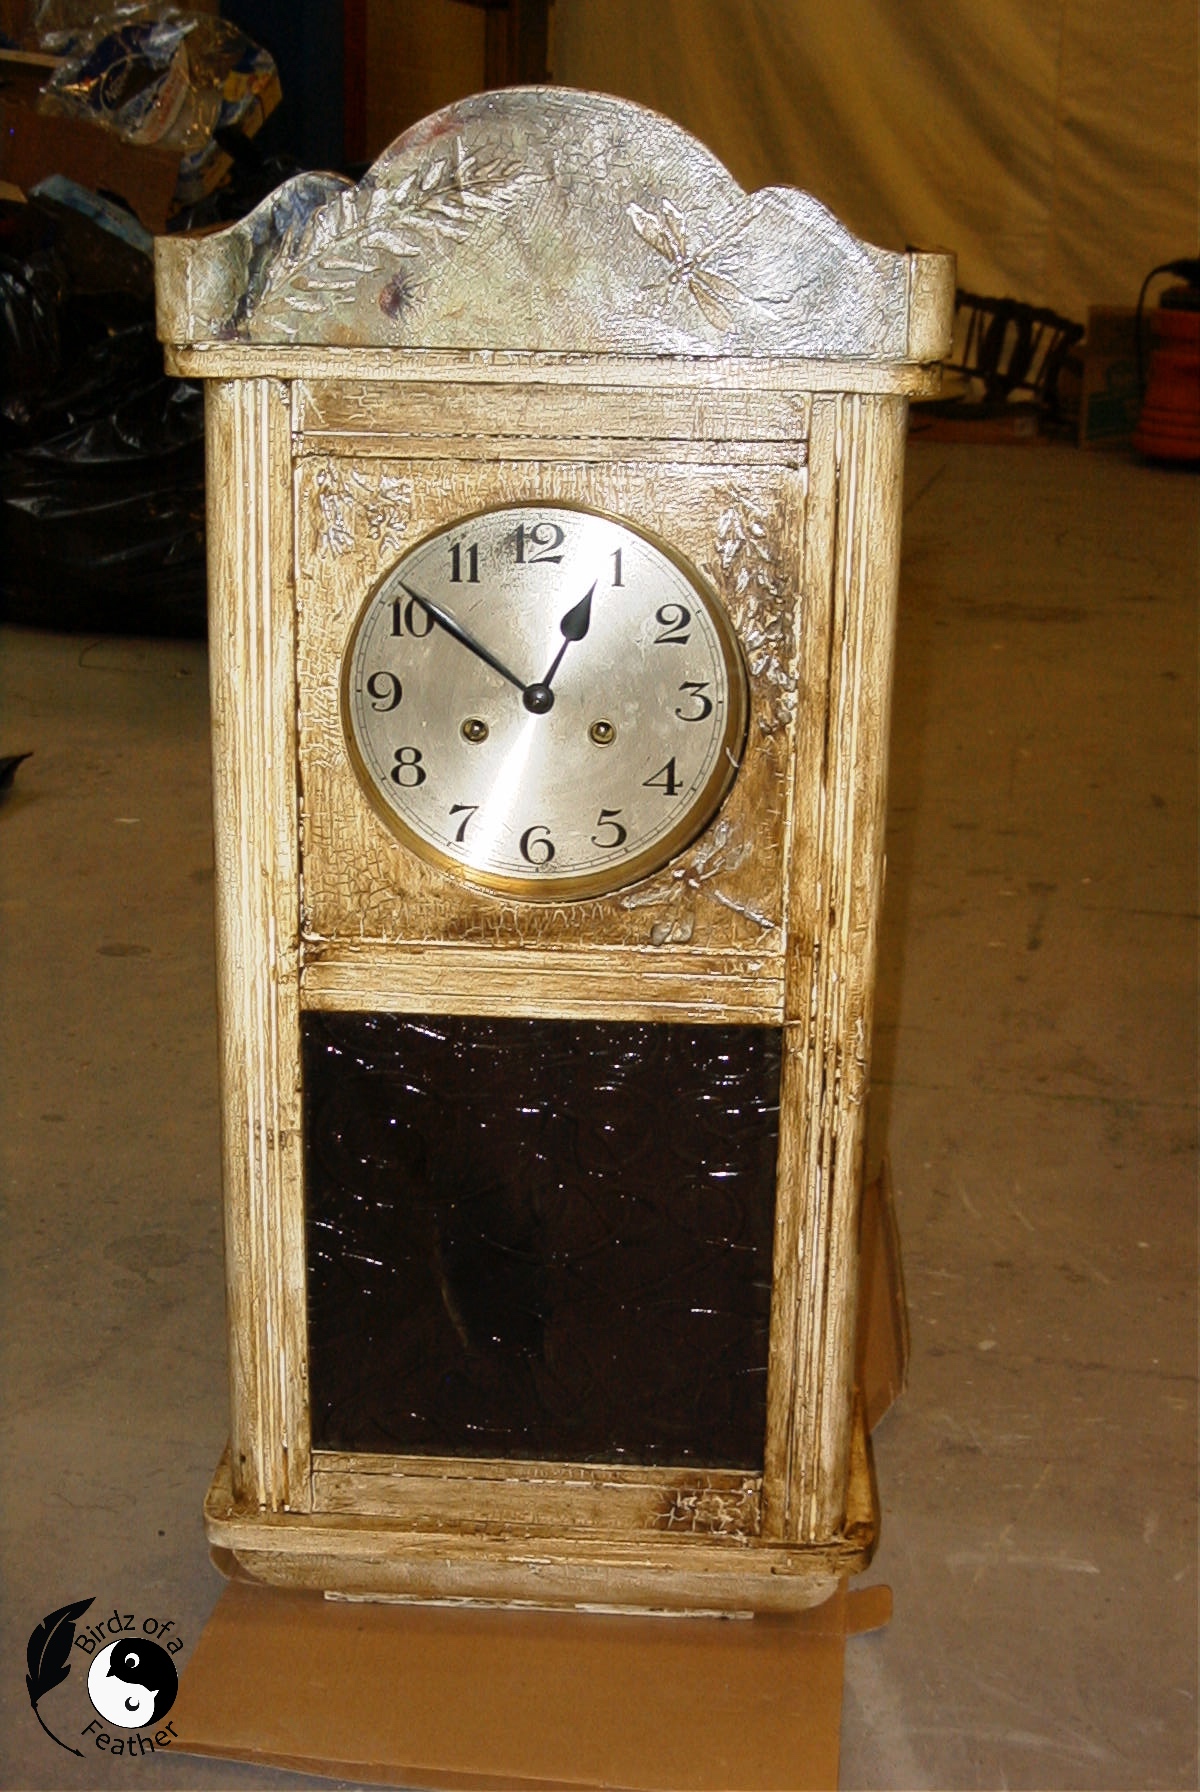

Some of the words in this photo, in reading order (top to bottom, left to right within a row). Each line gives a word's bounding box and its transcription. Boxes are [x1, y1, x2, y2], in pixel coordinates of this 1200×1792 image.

[448, 542, 480, 583] 11
[510, 522, 564, 563] 12
[610, 547, 626, 587] 1
[388, 597, 435, 638] 10
[654, 603, 691, 645] 2
[367, 671, 403, 712] 9
[675, 682, 713, 722] 3
[391, 746, 427, 787] 8
[642, 756, 684, 796] 4
[449, 805, 480, 843] 7
[591, 809, 628, 848] 5
[519, 825, 556, 864] 6
